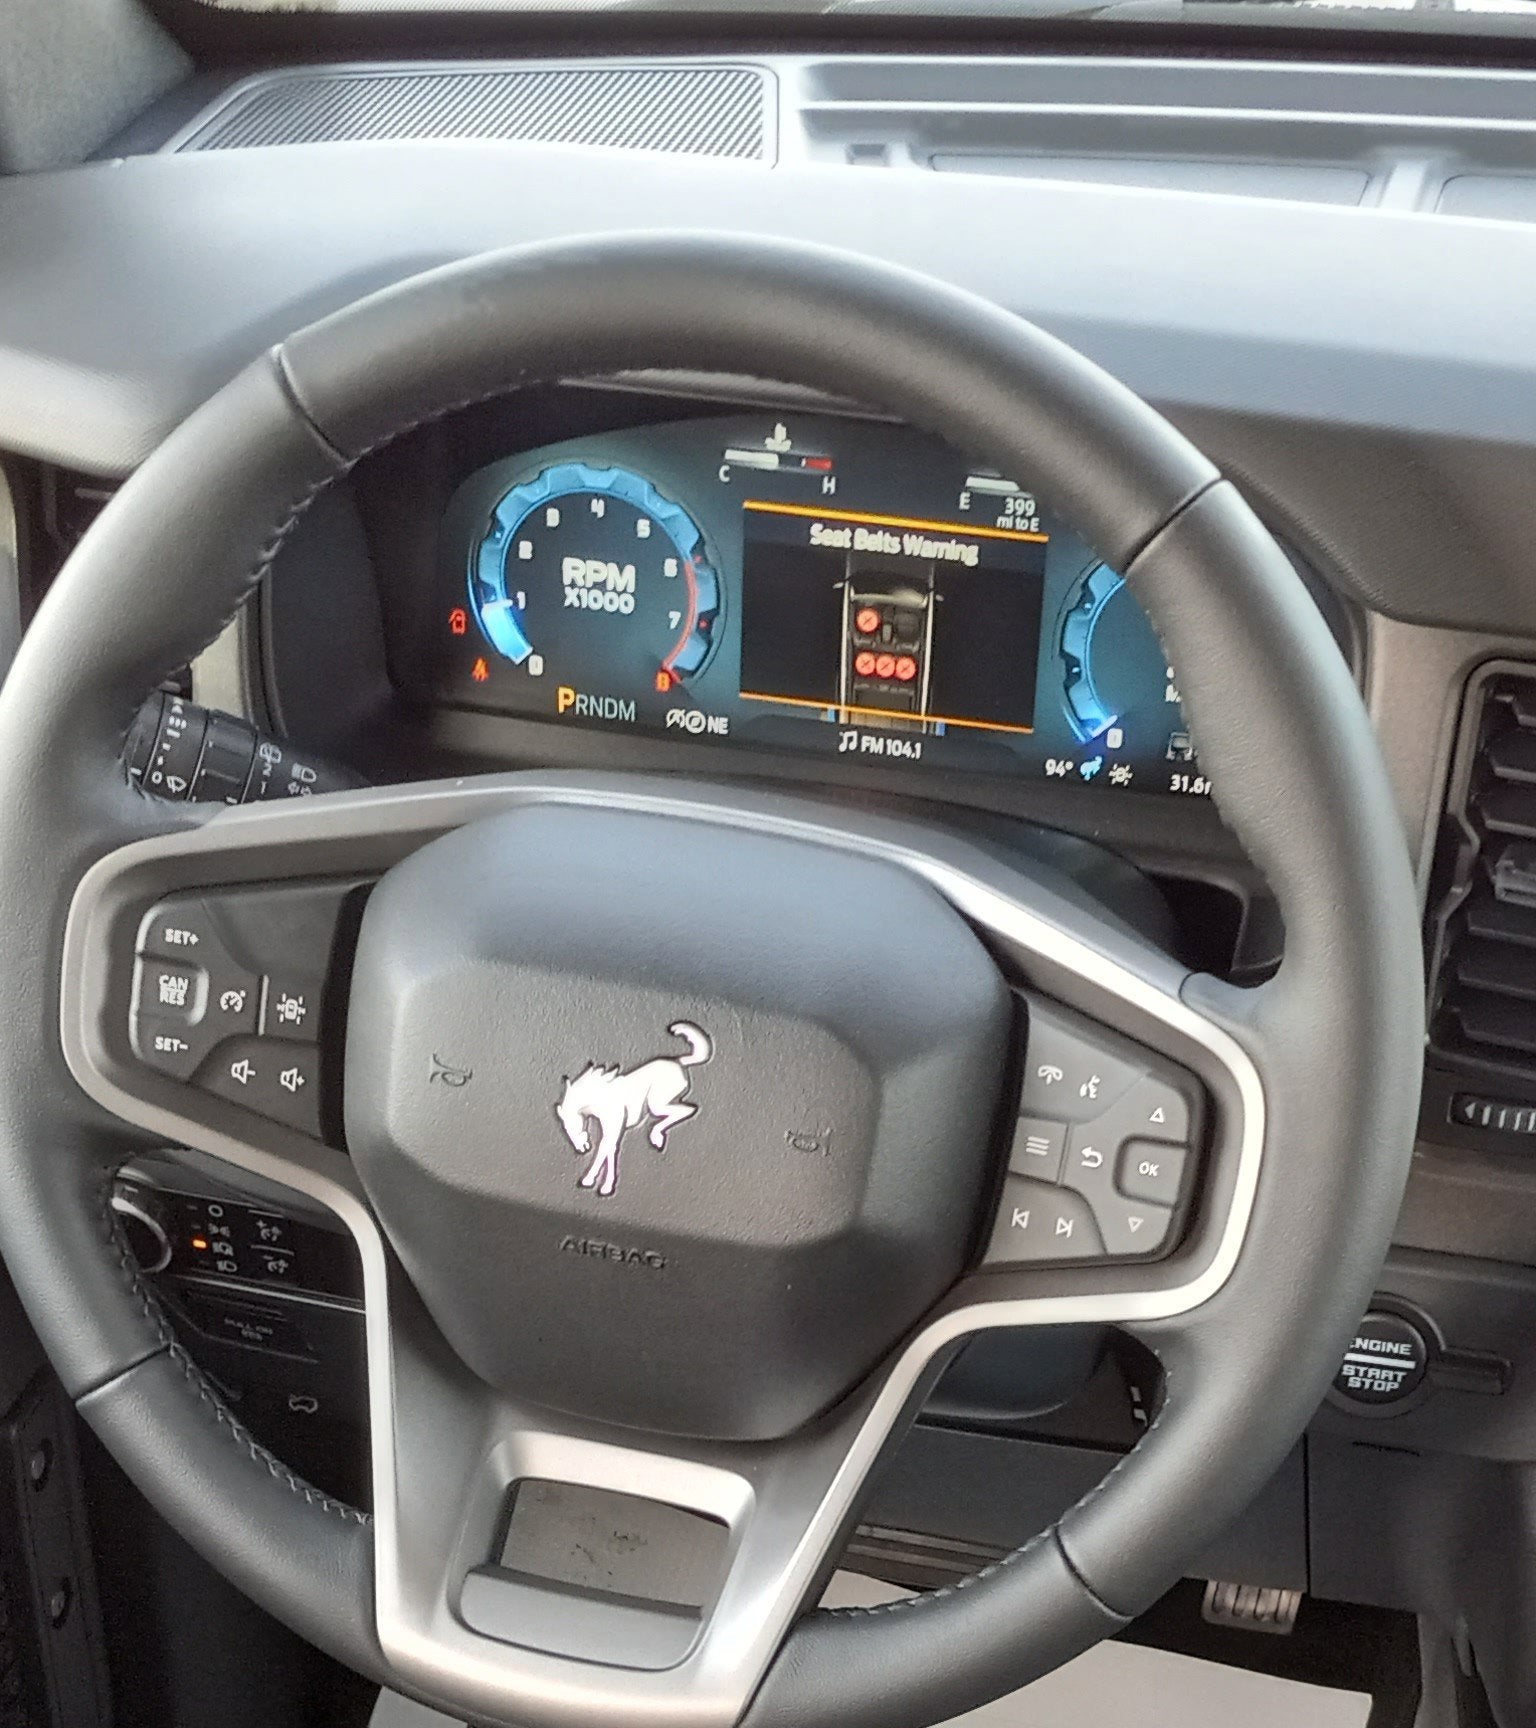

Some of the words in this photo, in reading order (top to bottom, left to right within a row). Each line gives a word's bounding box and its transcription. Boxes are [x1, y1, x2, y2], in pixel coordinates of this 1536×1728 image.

[719, 466, 730, 482] C
[822, 476, 836, 494] H
[591, 499, 605, 518] 4
[959, 492, 970, 510] E
[1004, 498, 1035, 516] 399
[637, 519, 650, 538] 5
[810, 523, 852, 548] Seat
[853, 528, 901, 553] Belts
[902, 534, 979, 566] Warning
[563, 557, 635, 593] RPM
[517, 591, 526, 609] 1
[564, 587, 635, 615] X1000
[668, 611, 681, 629] 7
[707, 717, 729, 735] NE
[861, 735, 885, 756] FM
[886, 739, 922, 760] 104.1
[159, 974, 189, 991] CAN
[1138, 1160, 1160, 1178] OK
[559, 1234, 667, 1269] AIRBAG
[1341, 1364, 1408, 1382] START
[1347, 1377, 1400, 1393] STOP
